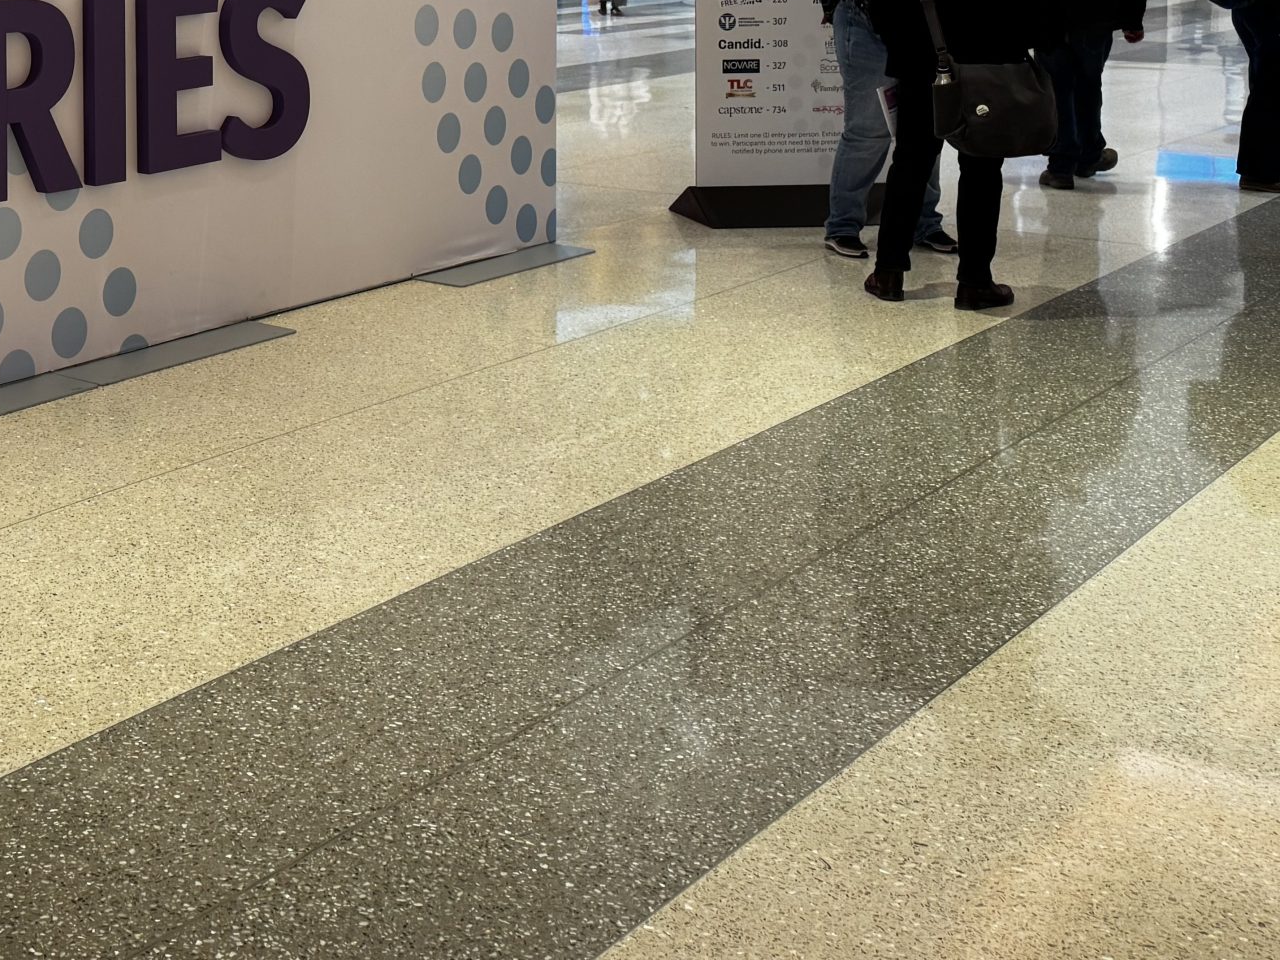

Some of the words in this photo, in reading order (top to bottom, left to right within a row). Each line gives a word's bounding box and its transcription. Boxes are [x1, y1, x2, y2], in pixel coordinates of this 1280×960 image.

[772, 17, 787, 25] 307
[718, 38, 764, 50] Candid.
[772, 40, 788, 48] 308
[723, 61, 759, 70] NOVARE
[772, 62, 786, 70] 327
[727, 79, 753, 89] TLC
[772, 84, 785, 92] 511
[718, 105, 763, 117] capstone
[772, 106, 787, 114] 734
